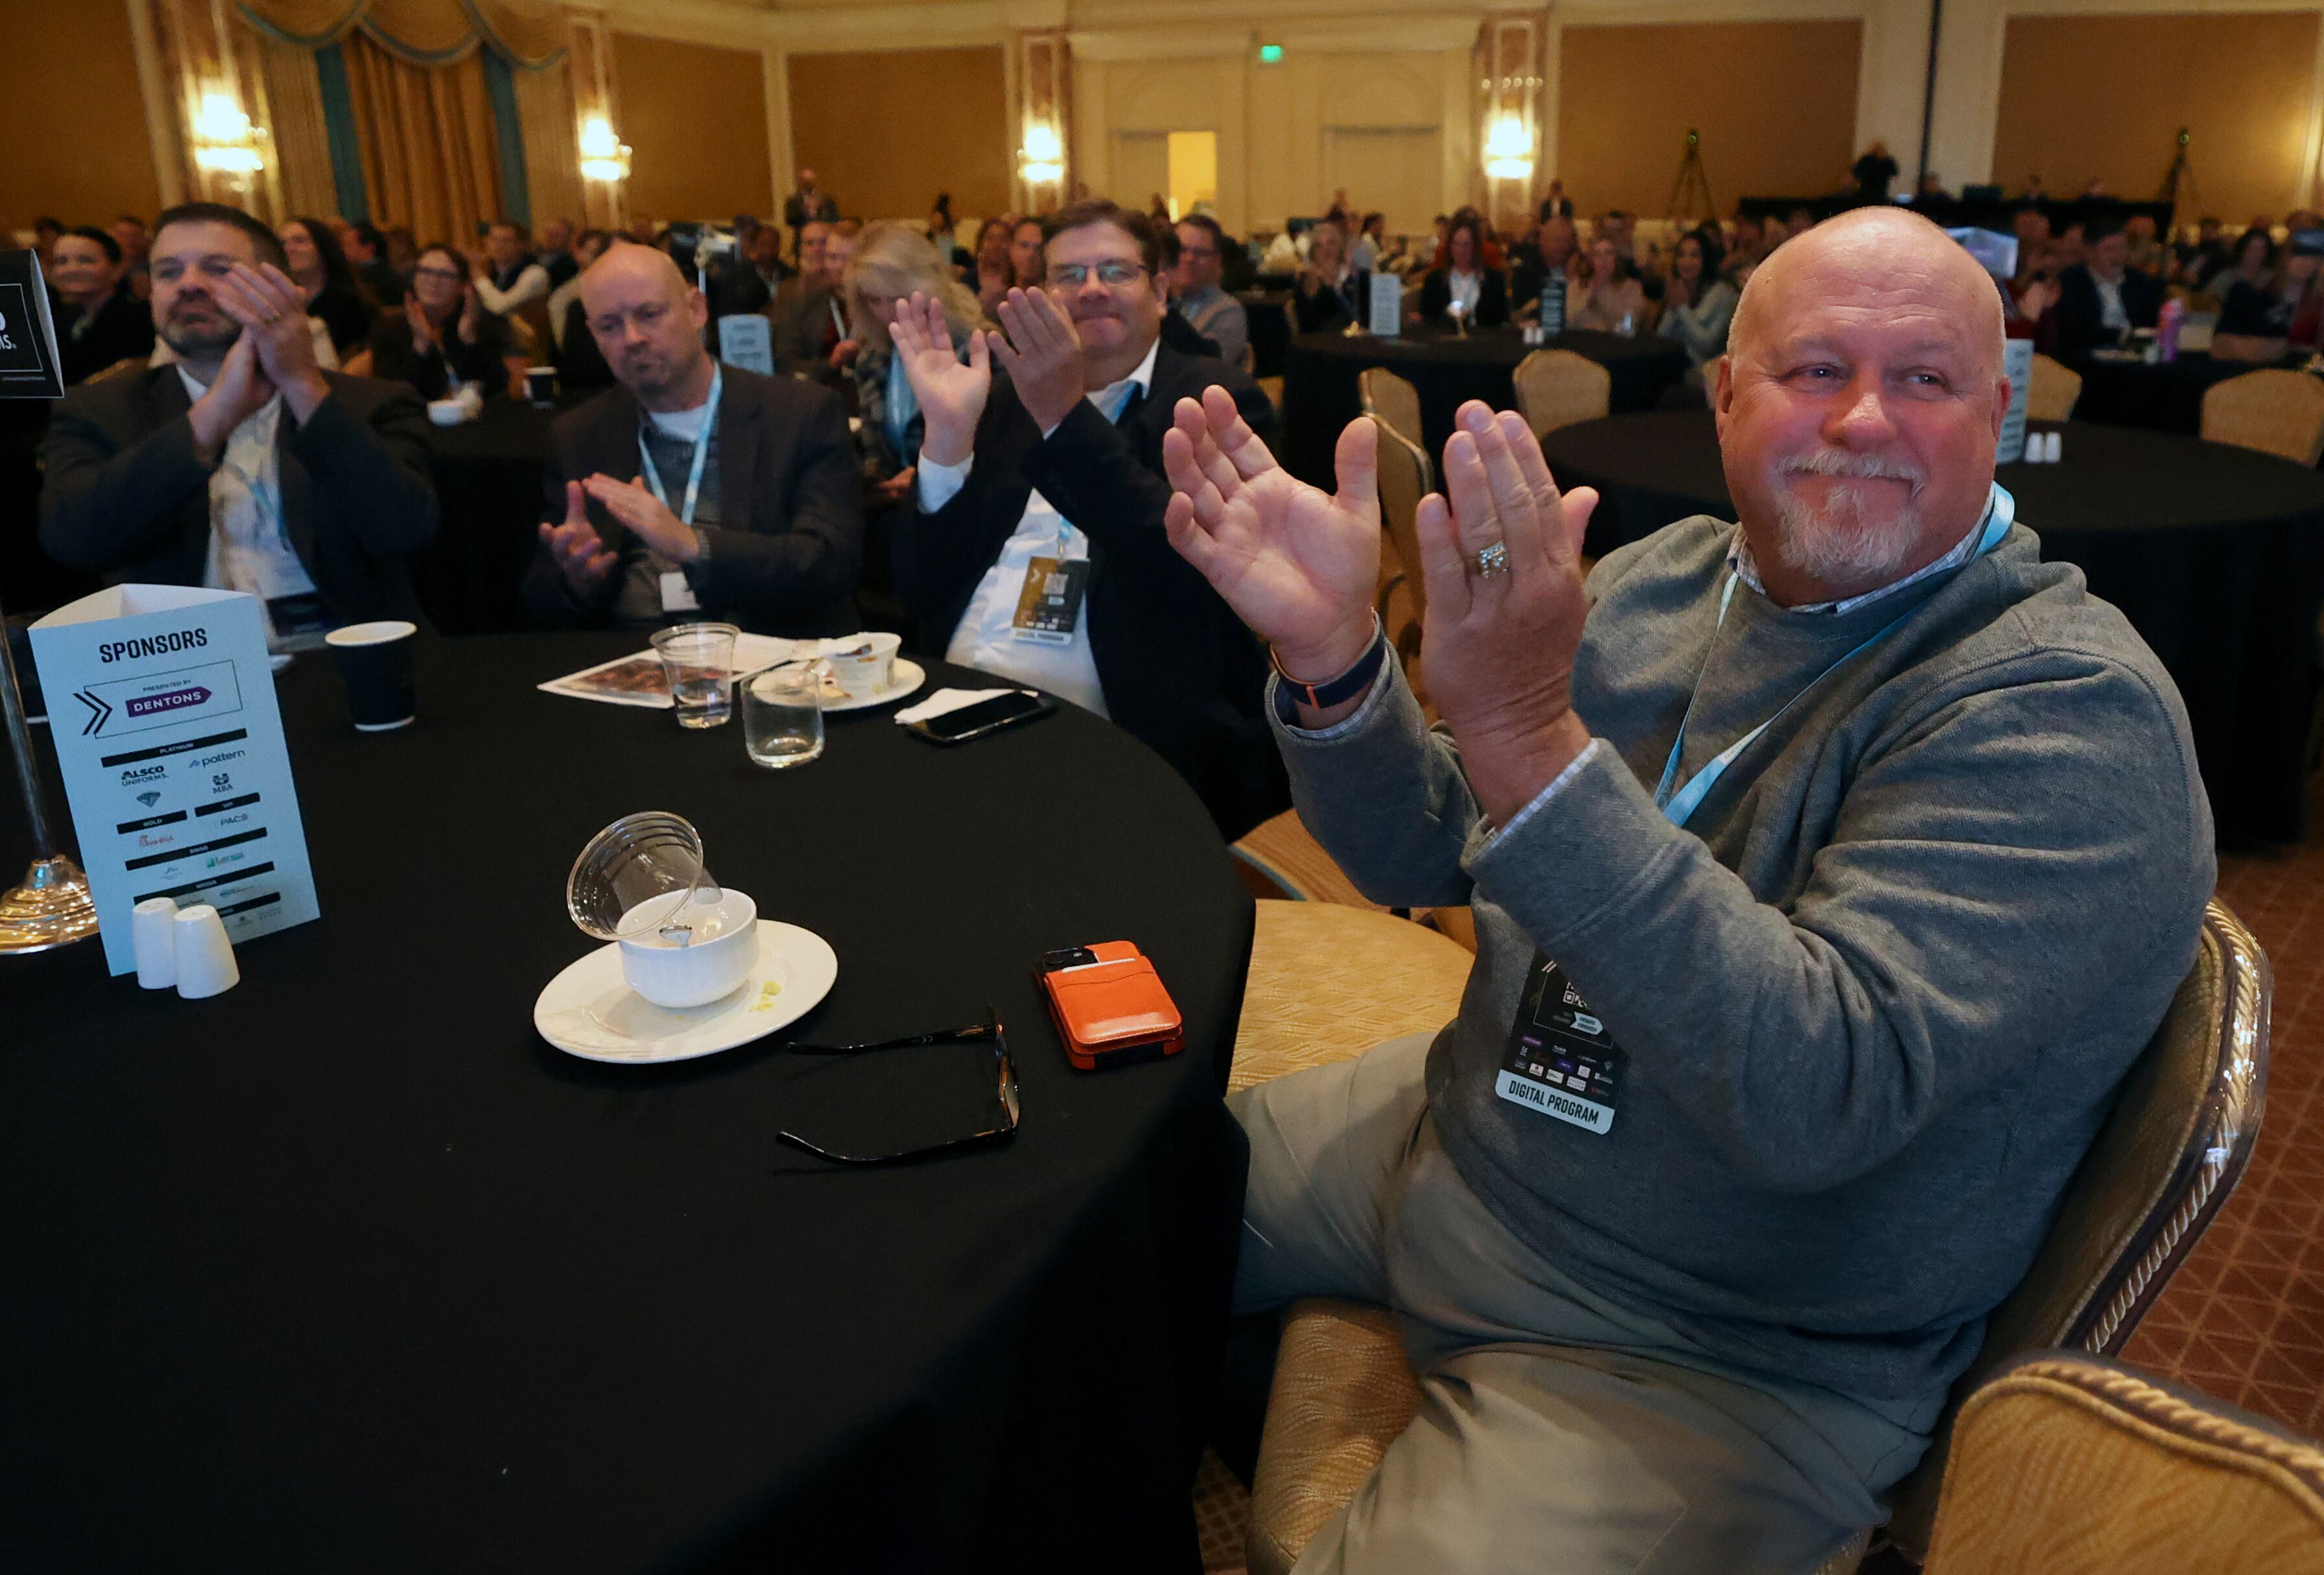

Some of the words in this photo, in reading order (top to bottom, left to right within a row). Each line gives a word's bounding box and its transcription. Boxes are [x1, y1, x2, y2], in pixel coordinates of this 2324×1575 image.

[99, 628, 208, 663] SPONSORS
[142, 681, 182, 692] PRESENTED
[134, 691, 201, 713] DENTONS
[160, 743, 194, 754] PLATINUM
[202, 750, 245, 767] pattern
[121, 765, 164, 780] ALSCO
[212, 784, 234, 794] MBA
[143, 818, 162, 827] GOLD
[220, 813, 248, 825] PACS
[1508, 1080, 1545, 1105] DIGITAL
[1547, 1095, 1599, 1124] PROGRAM
